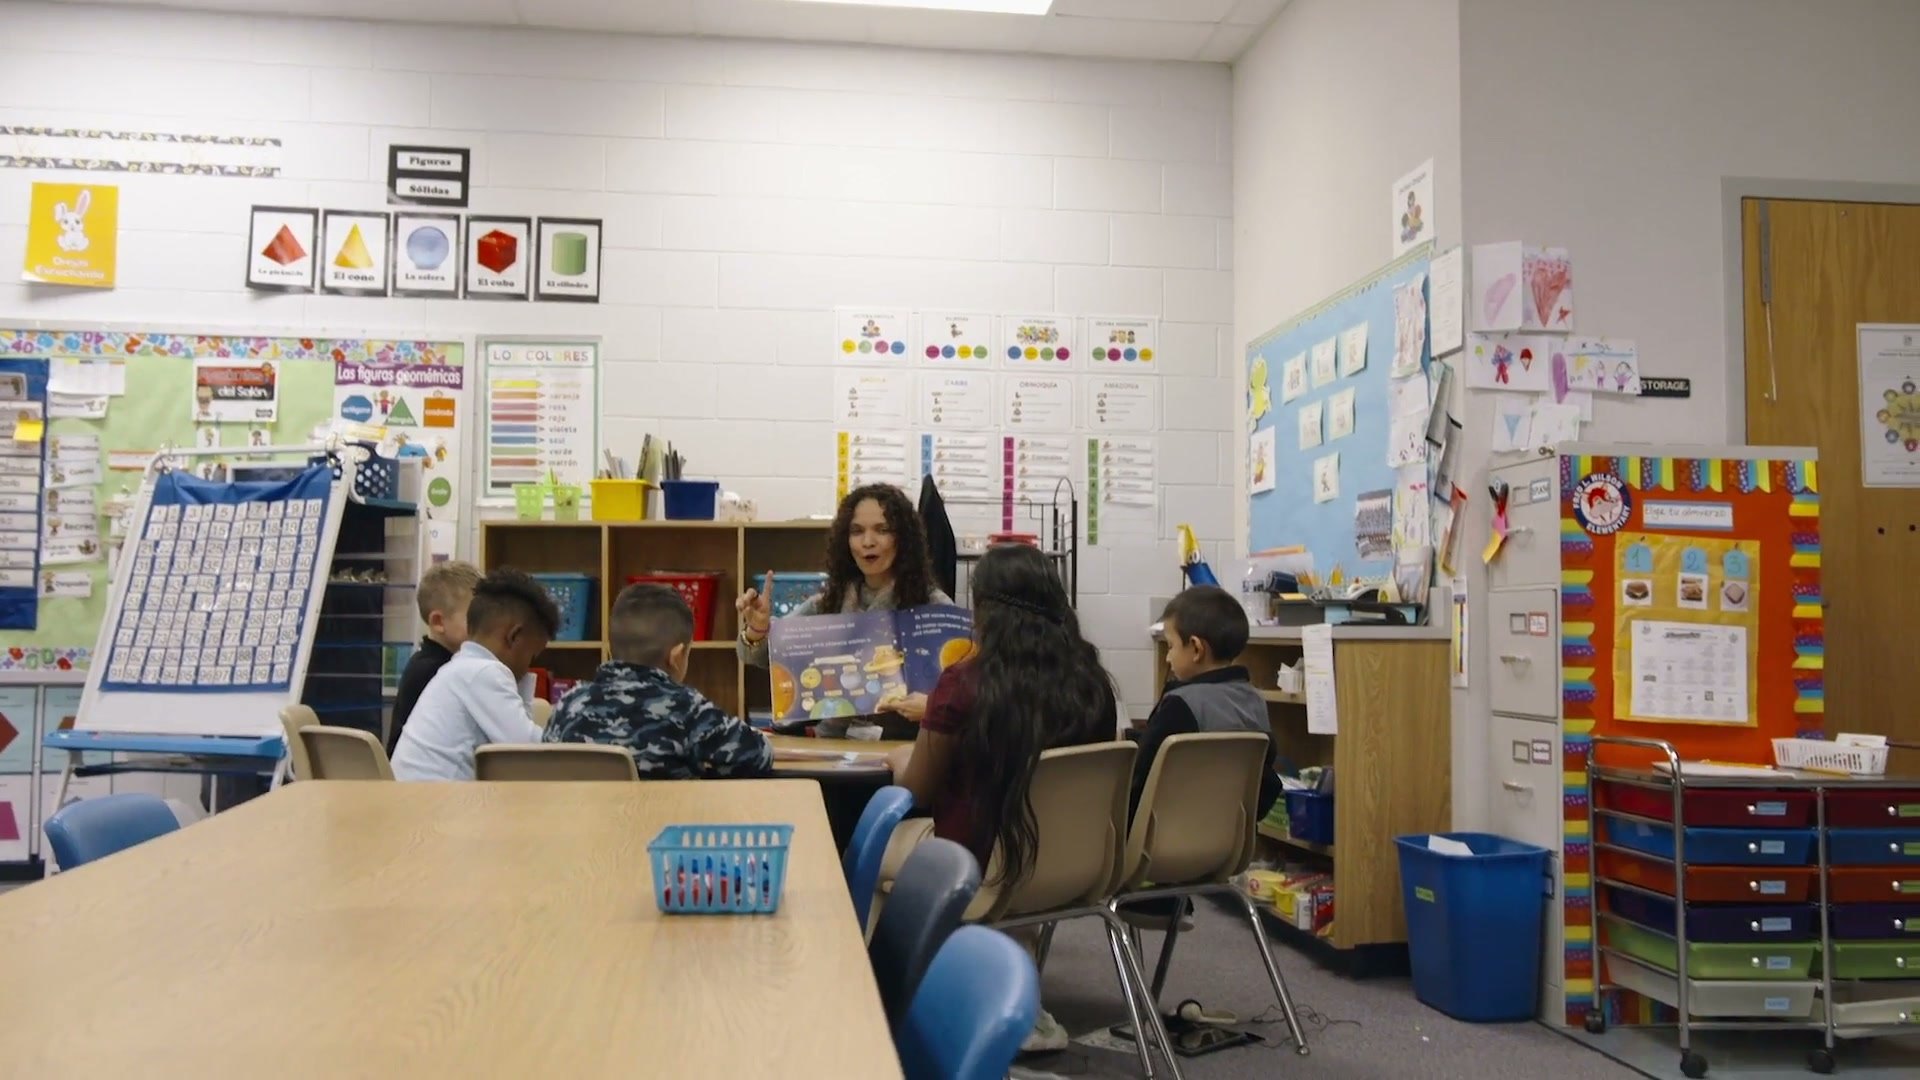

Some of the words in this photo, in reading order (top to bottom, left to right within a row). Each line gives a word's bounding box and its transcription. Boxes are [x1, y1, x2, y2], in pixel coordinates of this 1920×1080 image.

[409, 156, 451, 167] Figuras
[409, 184, 450, 195] Sólidas
[333, 271, 345, 281] El
[347, 273, 376, 282] cono
[405, 272, 416, 281] La
[478, 278, 489, 288] El
[491, 279, 516, 289] cubo
[546, 280, 556, 289] El
[337, 365, 356, 381] Las
[357, 363, 394, 385] figuras
[395, 366, 462, 386] geométricas
[1641, 380, 1689, 390] STORAGE
[549, 448, 572, 456] verde
[1590, 472, 1624, 490] WILSON
[1585, 504, 1632, 535] ELEMENTARY
[1631, 551, 1640, 568] 1
[1686, 553, 1701, 570] 2
[1728, 555, 1742, 571] 3
